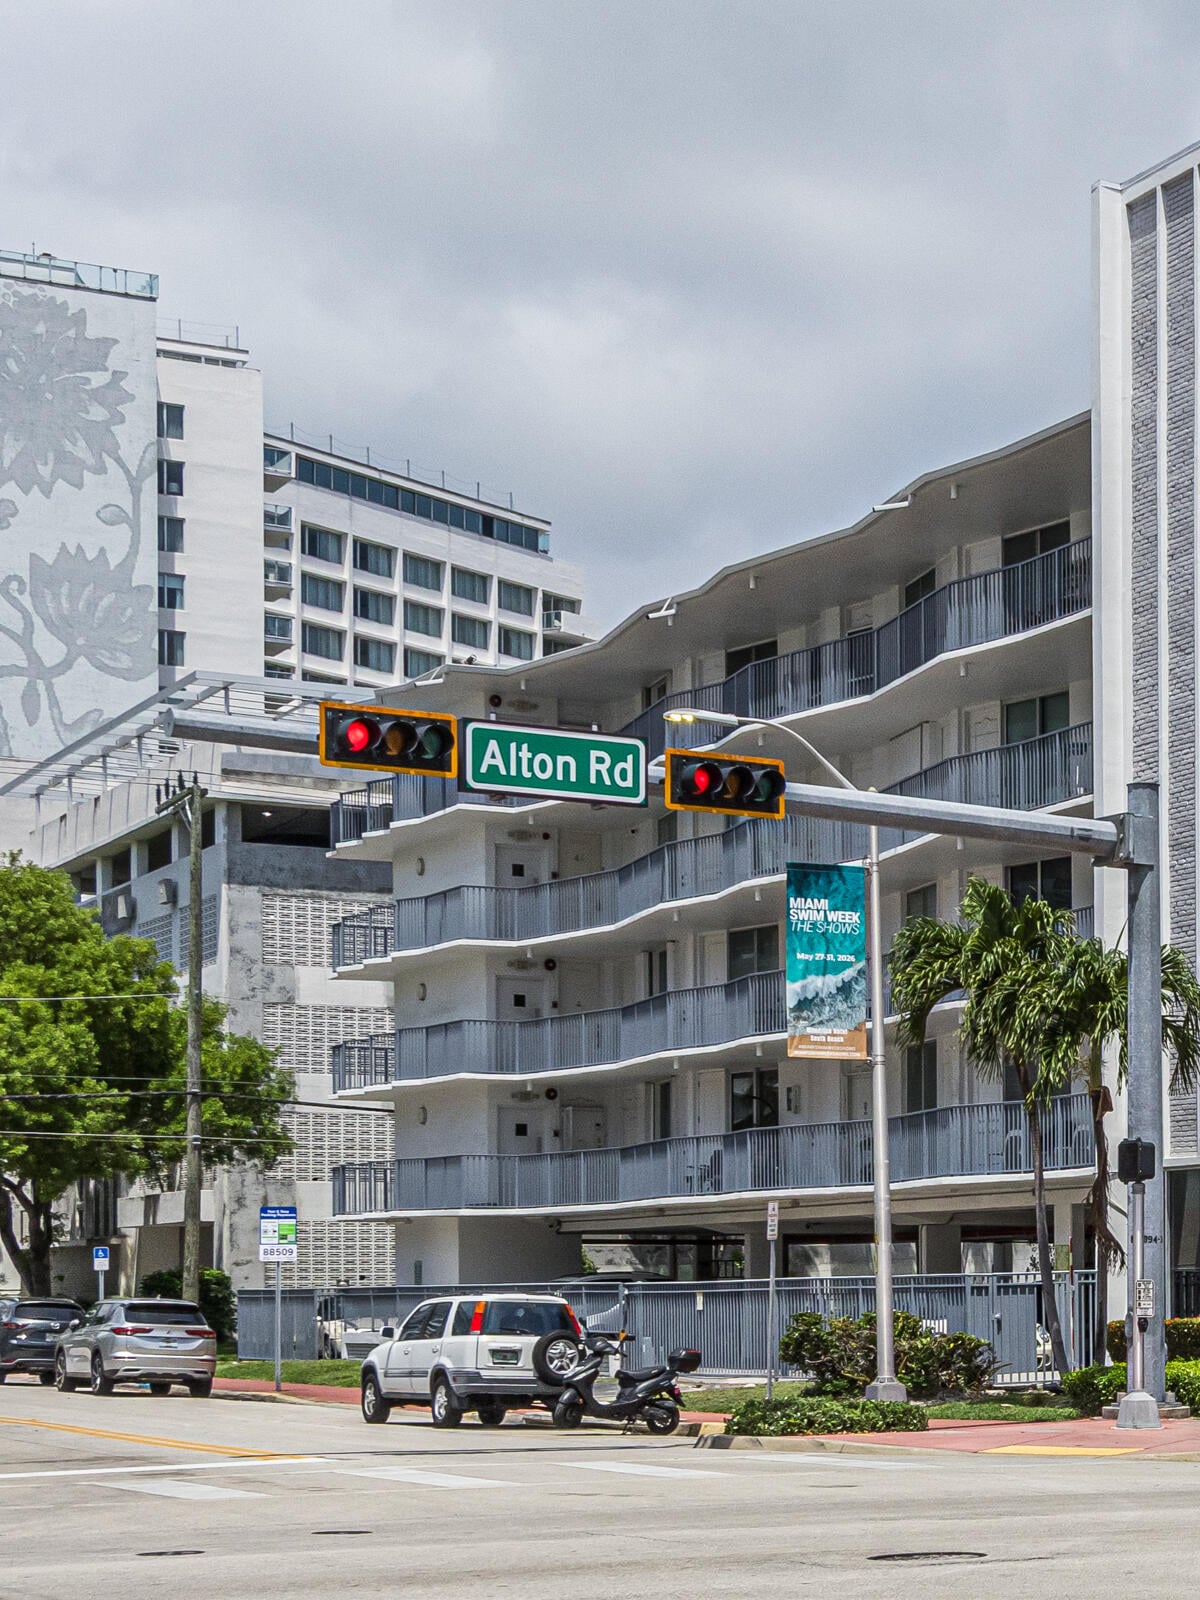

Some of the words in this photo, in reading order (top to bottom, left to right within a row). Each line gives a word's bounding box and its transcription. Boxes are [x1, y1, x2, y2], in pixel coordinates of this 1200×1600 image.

[480, 739, 577, 782] Alton
[589, 750, 634, 788] Rd
[789, 897, 828, 910] MIAMI
[789, 909, 825, 921] SWIM
[826, 910, 861, 923] WEEK
[790, 920, 815, 932] THE
[816, 921, 860, 935] SHOWS
[796, 952, 814, 961] May
[837, 954, 856, 962] 2026
[263, 1248, 294, 1256] 88509
